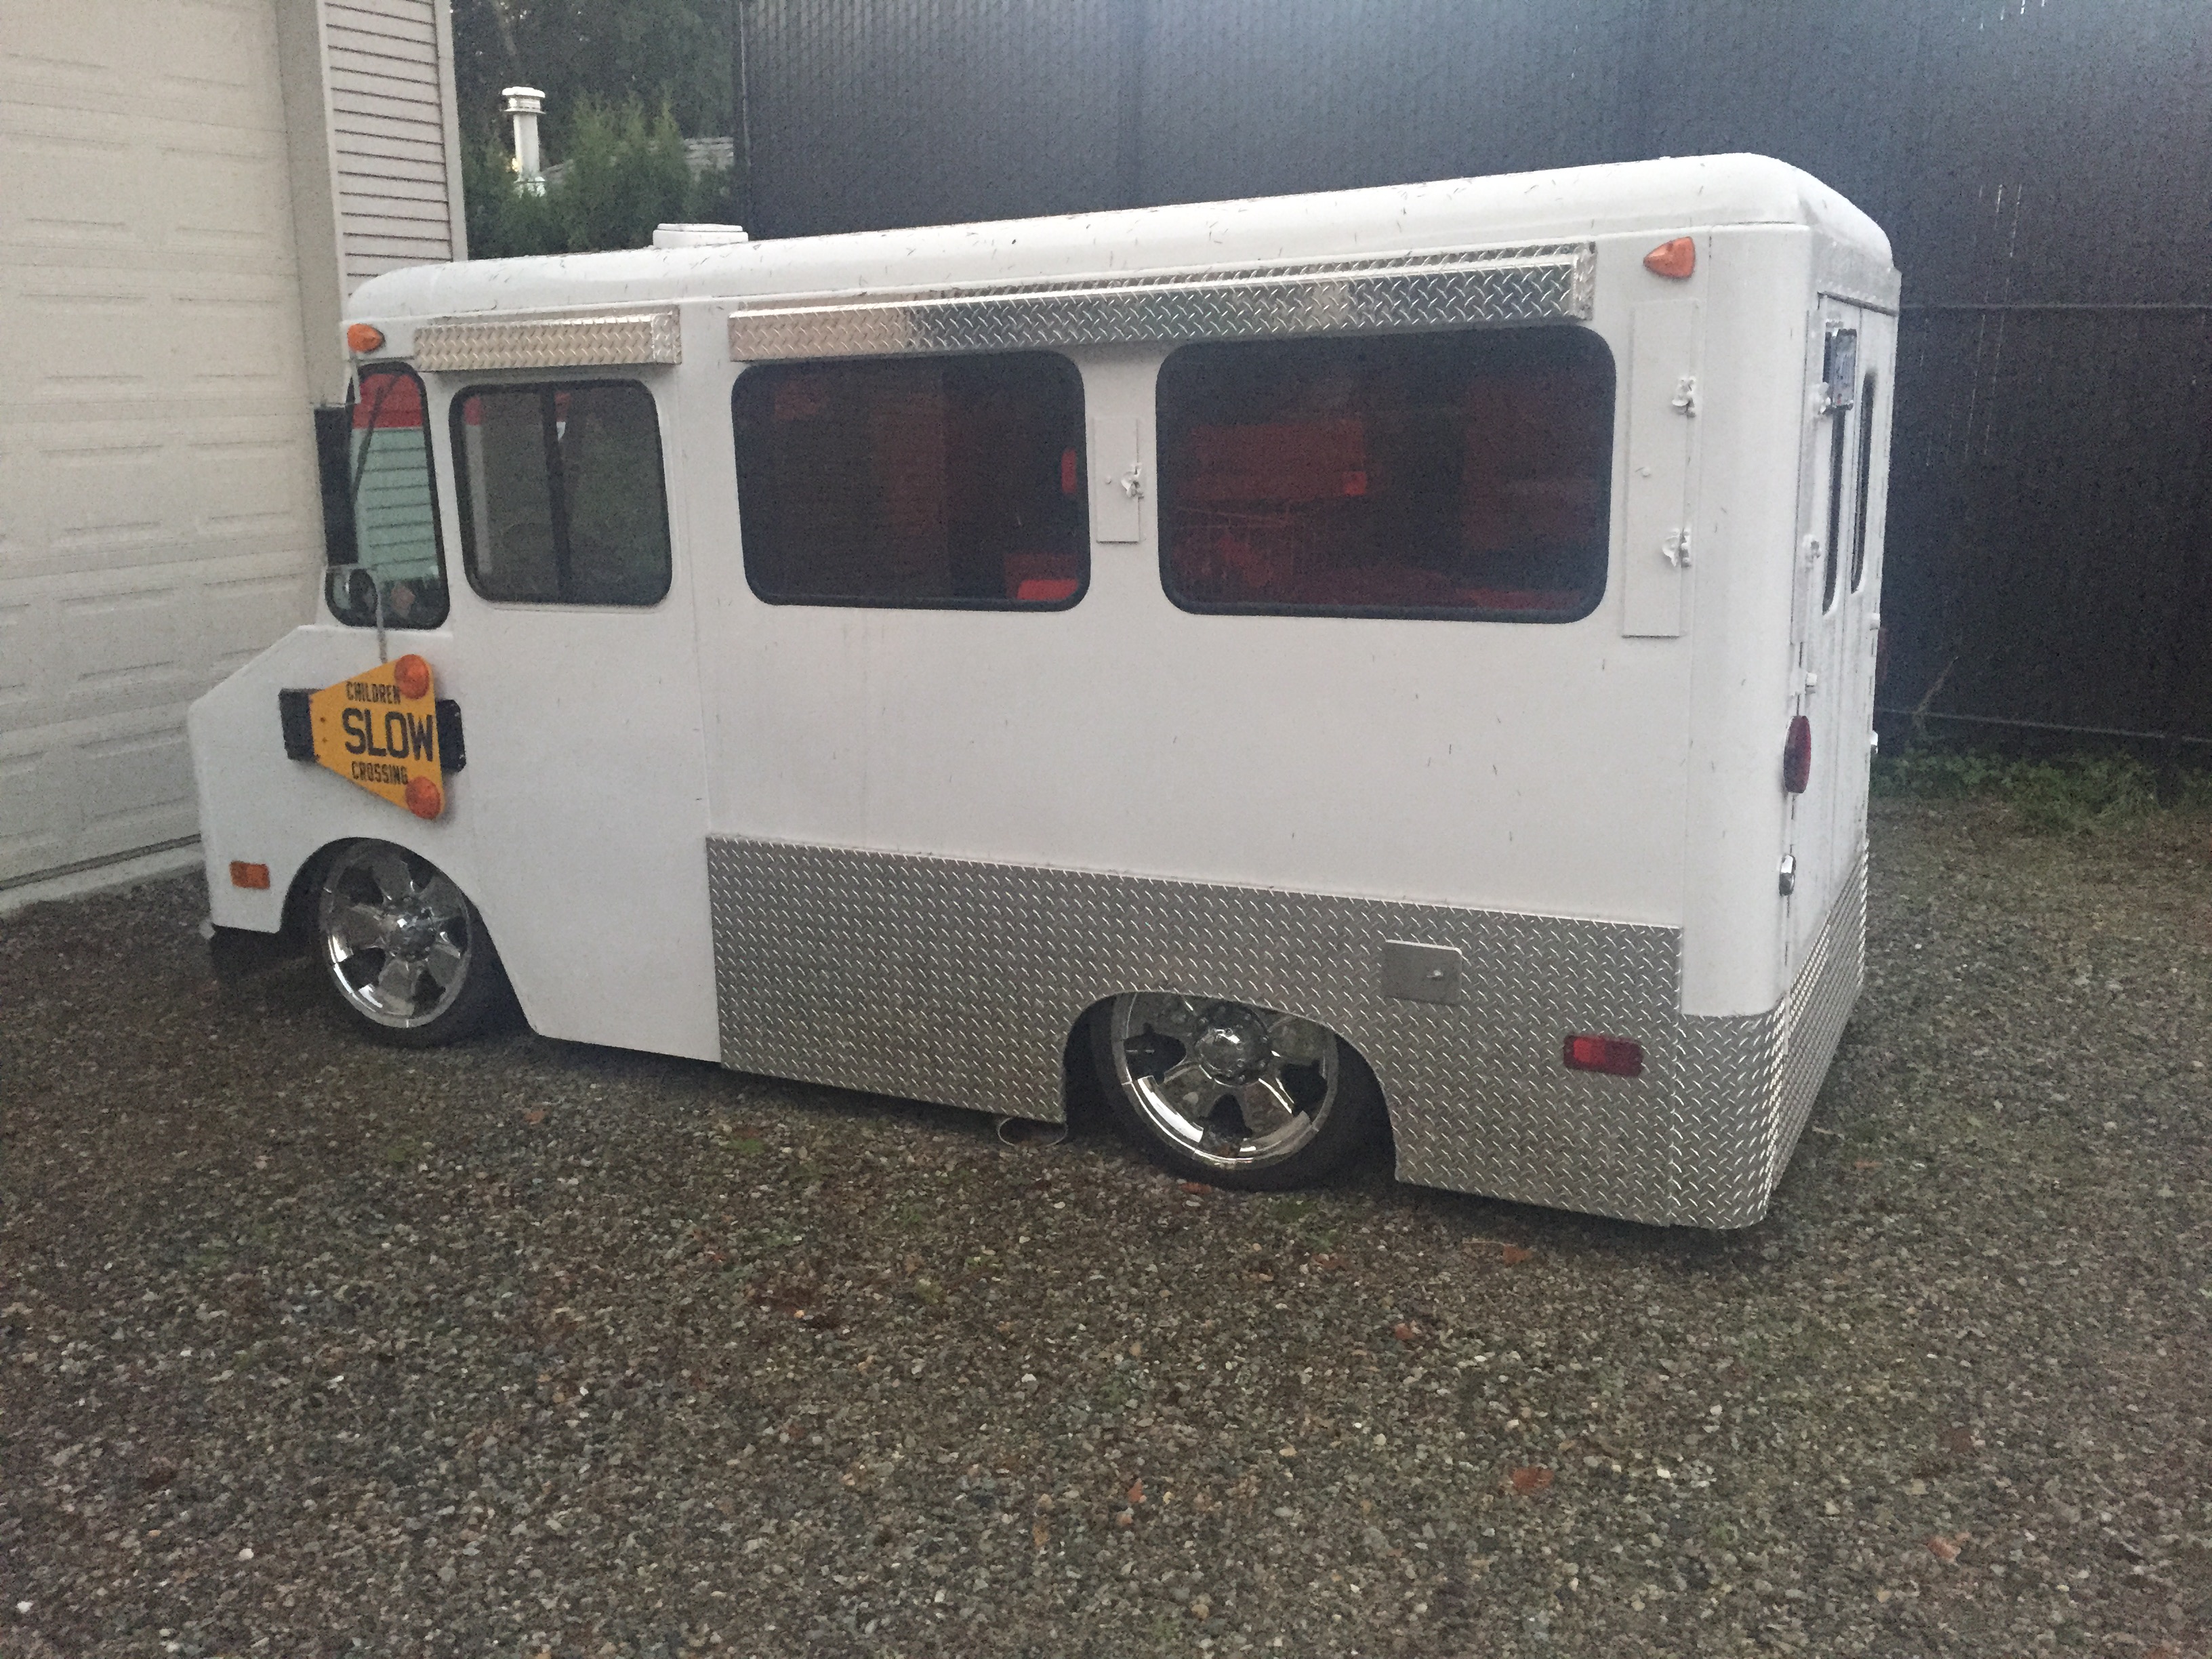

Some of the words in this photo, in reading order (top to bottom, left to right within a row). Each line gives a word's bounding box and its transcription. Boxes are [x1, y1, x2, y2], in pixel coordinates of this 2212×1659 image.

[346, 681, 401, 704] CHILDREN
[342, 708, 433, 762] SLOW
[351, 760, 408, 785] CROSSING
